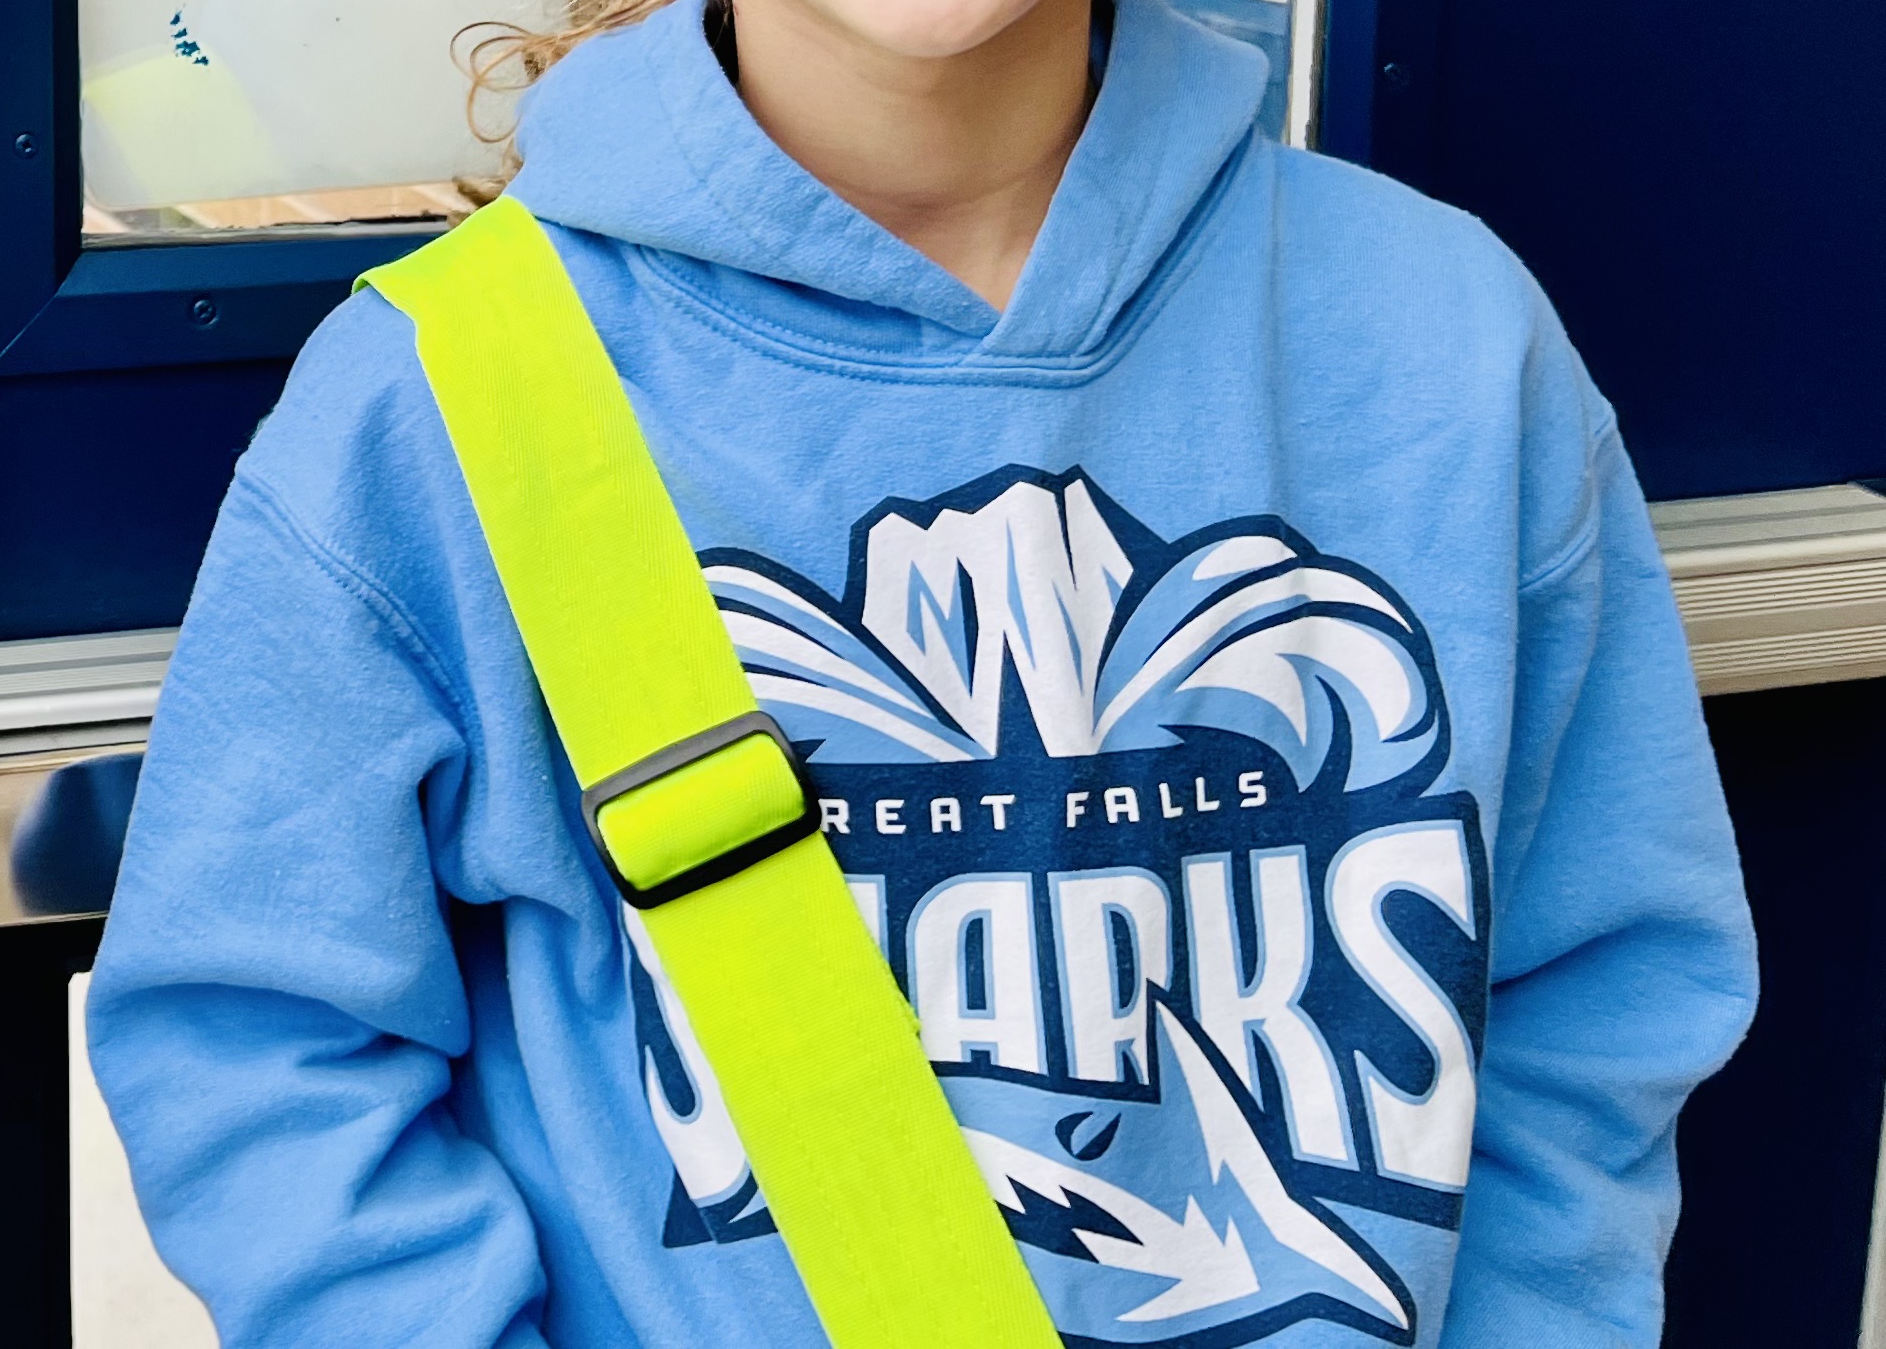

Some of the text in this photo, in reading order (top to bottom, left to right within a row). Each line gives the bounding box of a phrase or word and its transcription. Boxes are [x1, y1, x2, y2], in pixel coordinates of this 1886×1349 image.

[818, 770, 1271, 834] REAT FALLS
[623, 818, 1478, 1206] ARKS
